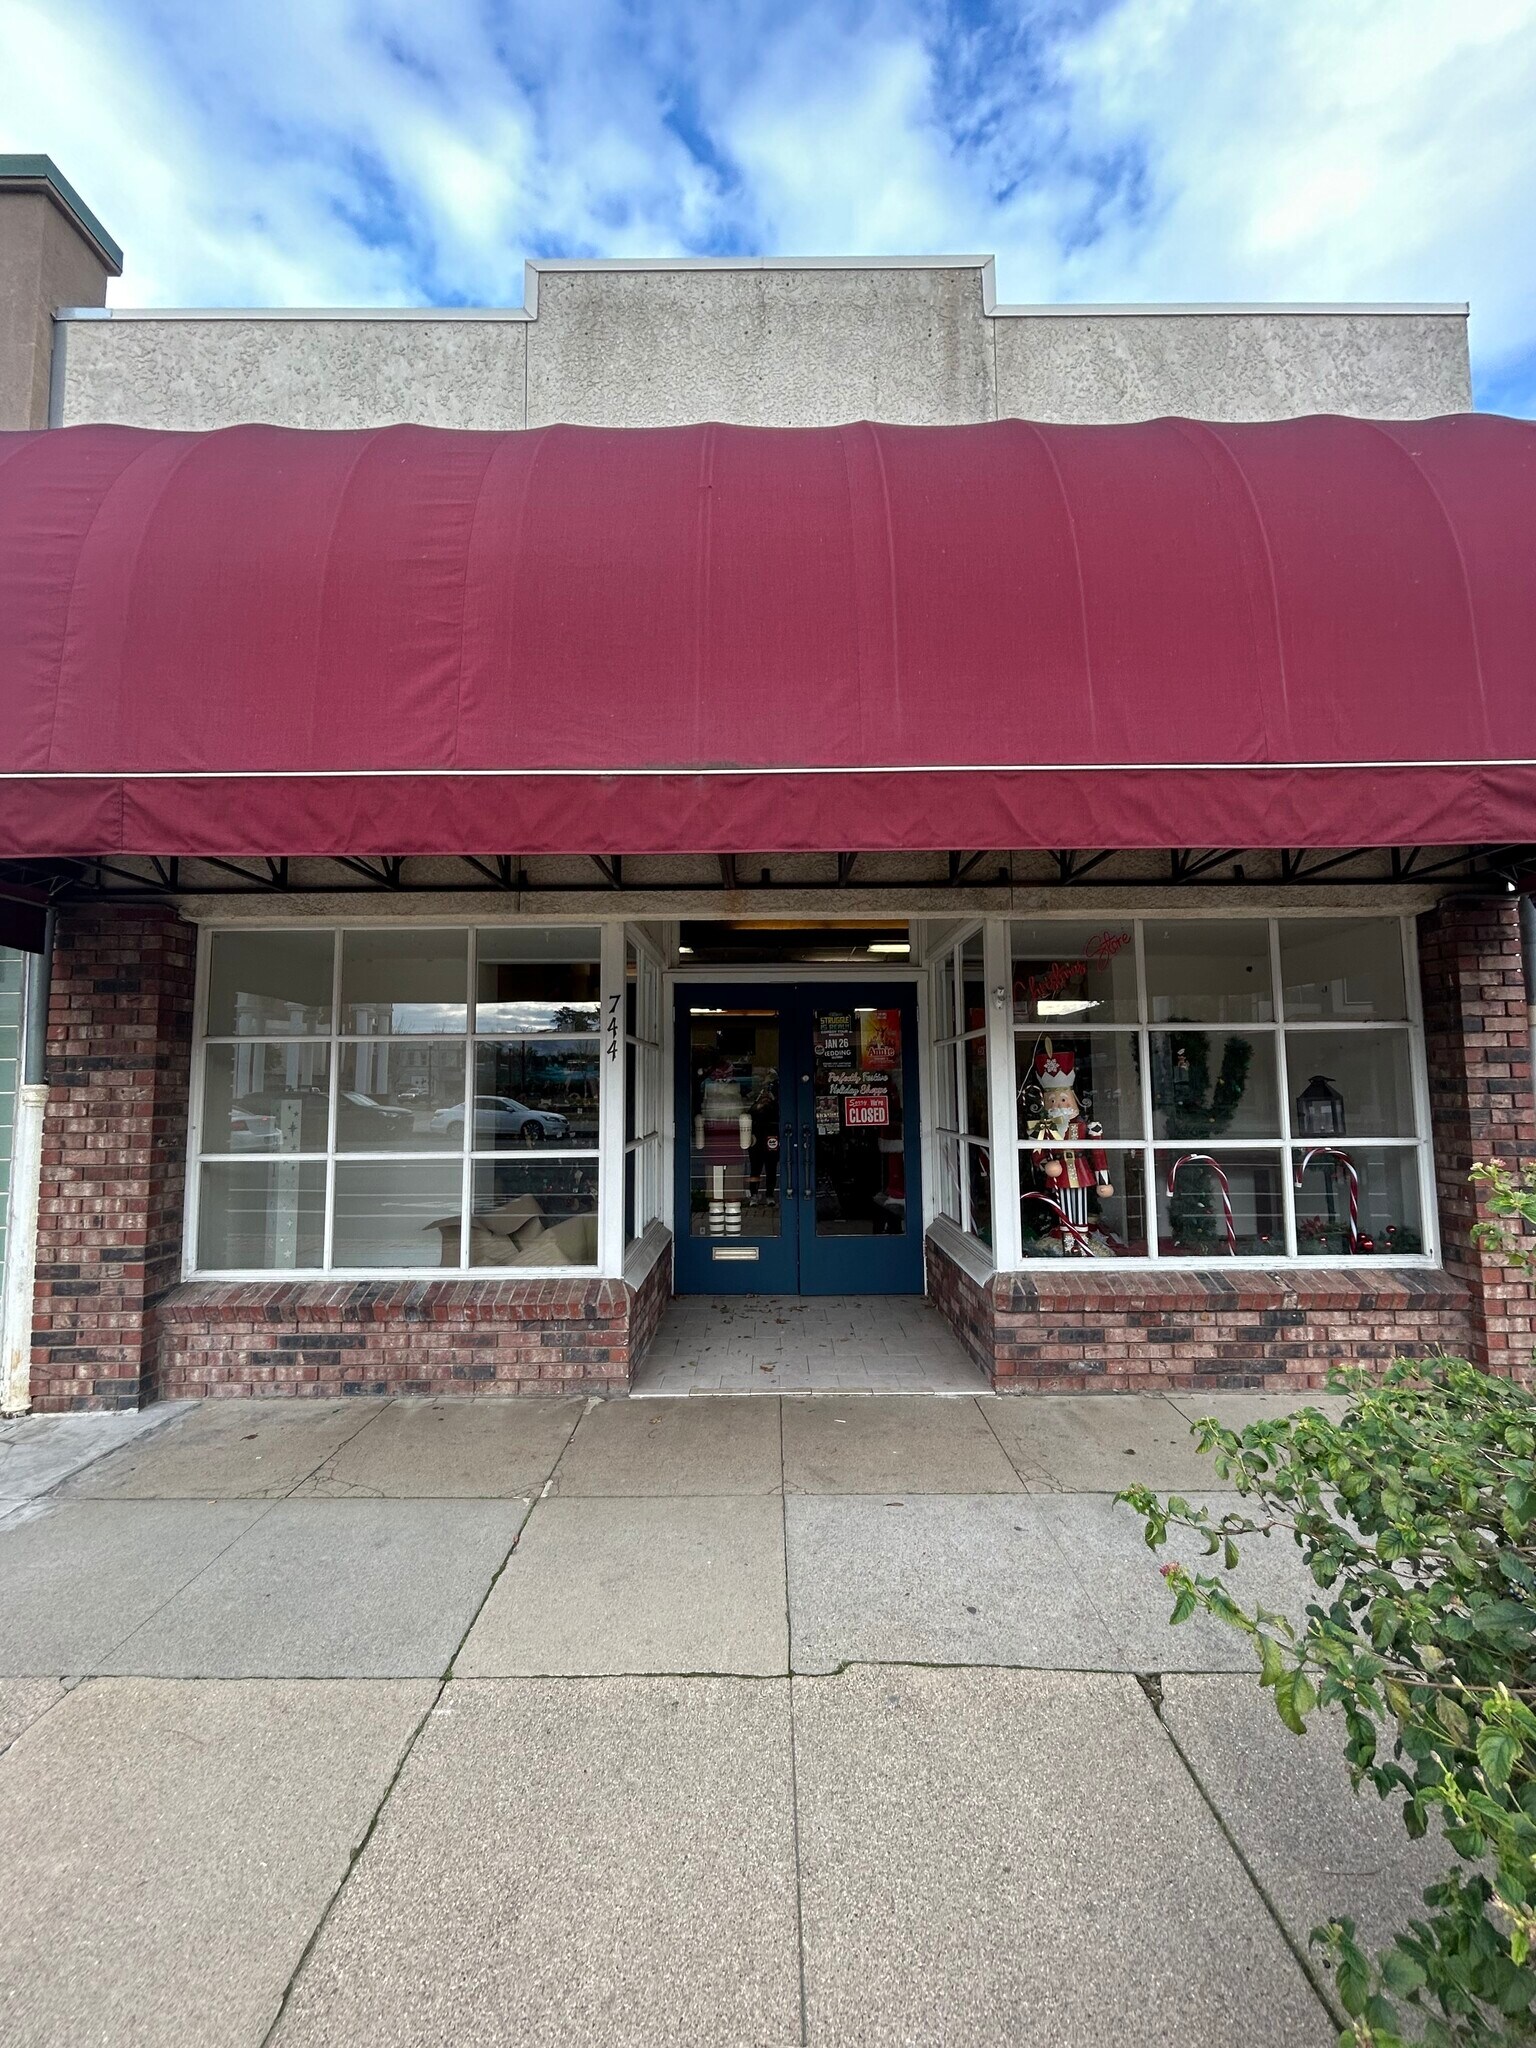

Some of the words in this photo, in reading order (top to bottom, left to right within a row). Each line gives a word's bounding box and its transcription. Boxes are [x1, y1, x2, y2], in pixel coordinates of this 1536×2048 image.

[1085, 931, 1132, 972] Store
[606, 994, 621, 1062] 744
[825, 1039, 838, 1049] JAN
[838, 1038, 849, 1048] 26
[868, 1046, 894, 1056] Annie
[828, 1072, 861, 1084] Perfectly
[862, 1071, 889, 1082] Festive
[829, 1084, 859, 1096] Holiday
[859, 1083, 888, 1096] Shoppe
[848, 1099, 867, 1107] Sorry
[849, 1107, 885, 1123] CLOSED
